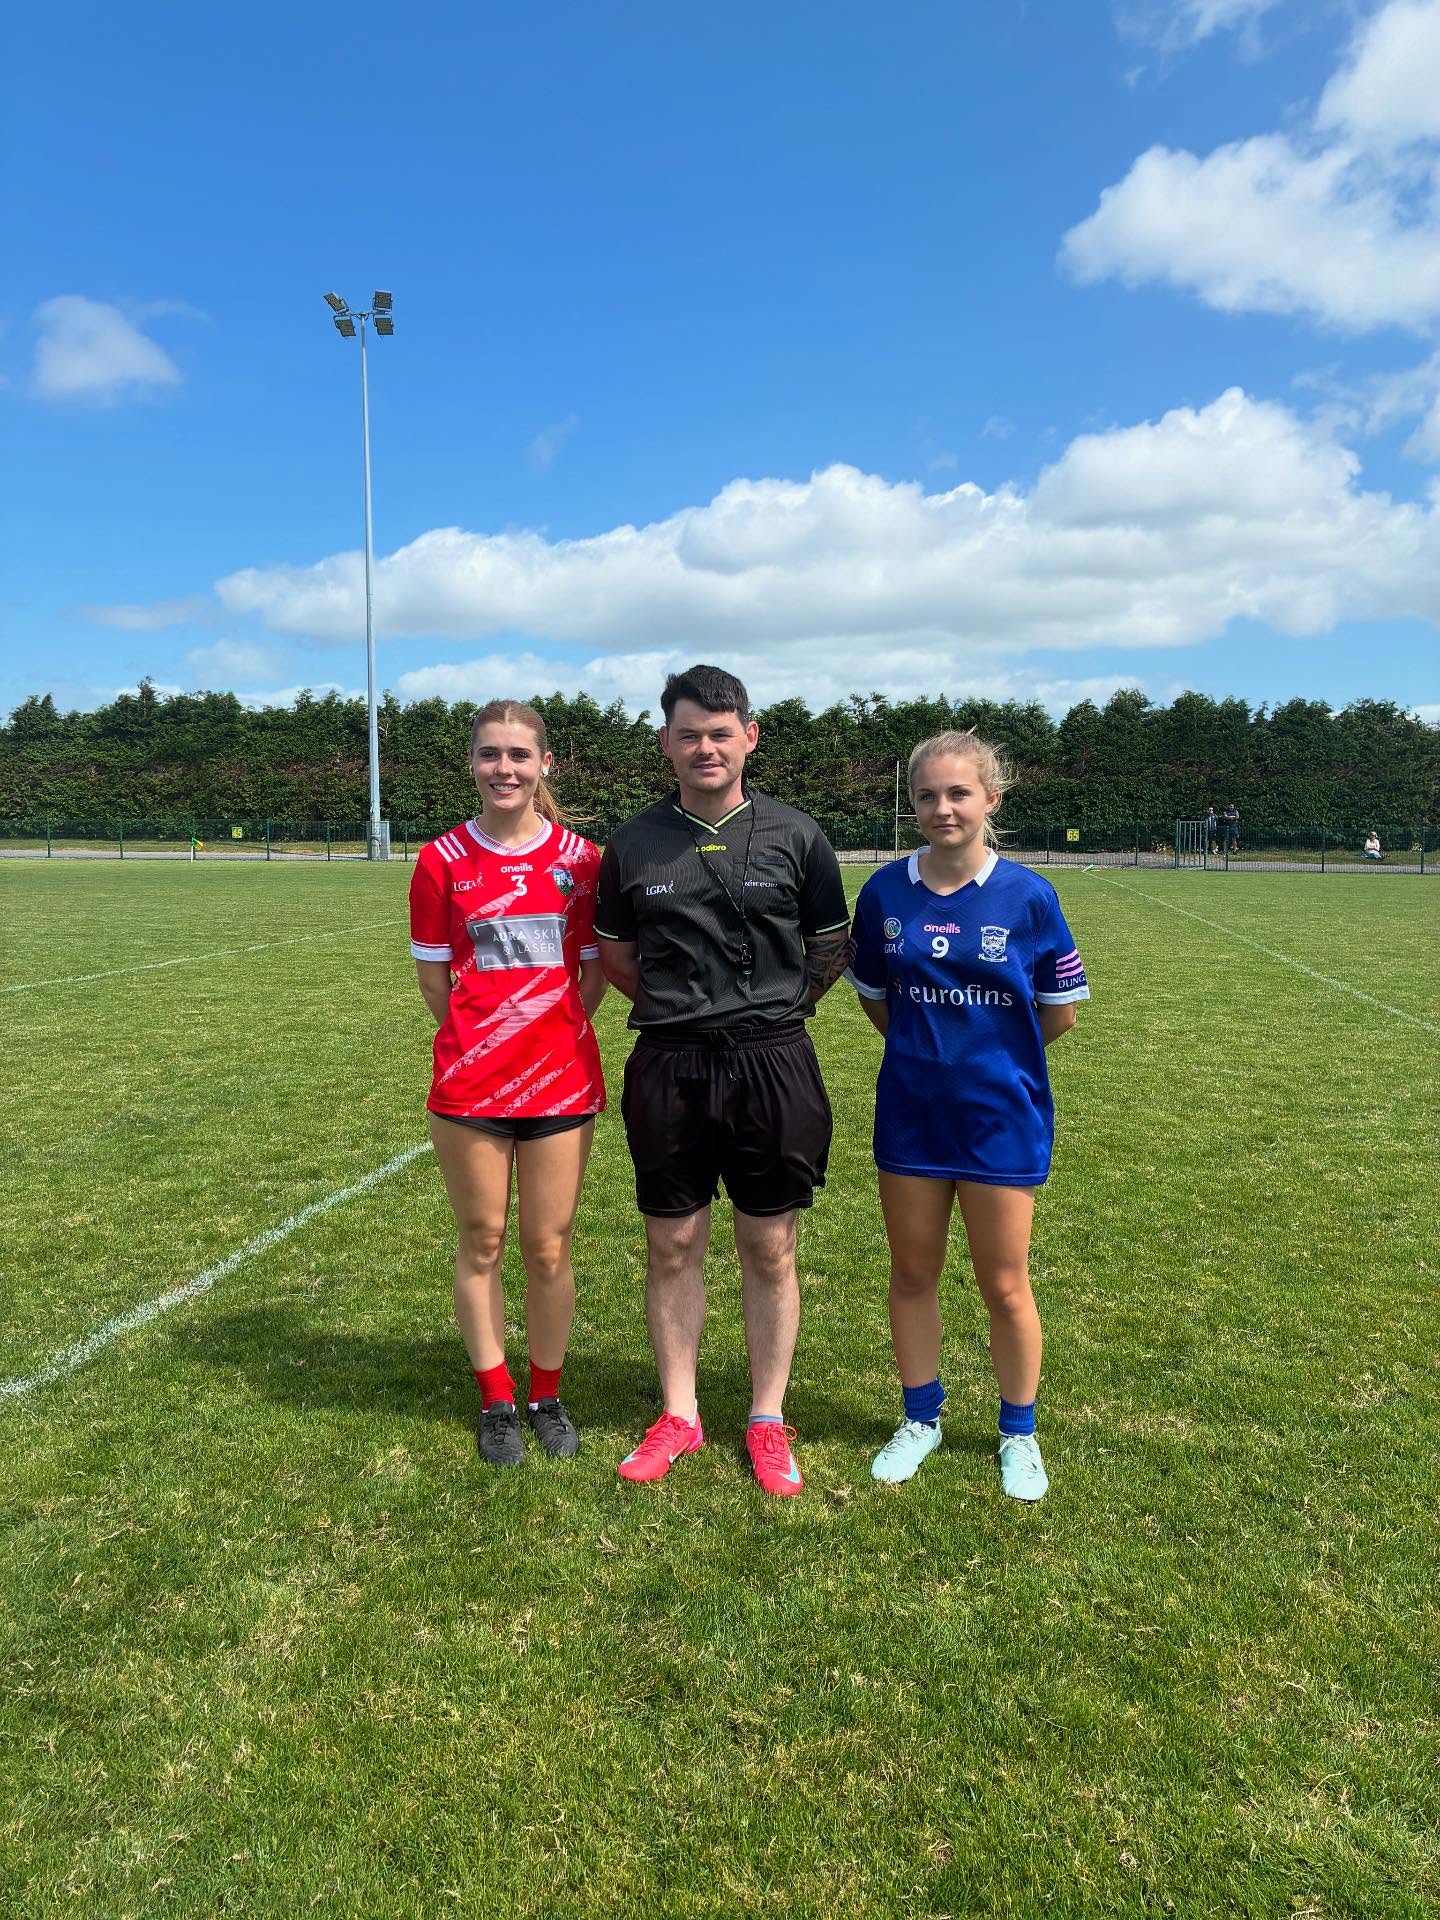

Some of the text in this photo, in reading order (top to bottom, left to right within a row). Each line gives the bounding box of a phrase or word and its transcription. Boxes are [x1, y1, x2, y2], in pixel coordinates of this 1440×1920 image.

[1067, 830, 1079, 841] 65
[511, 874, 528, 897] 3
[646, 884, 668, 896] LGFA
[493, 930, 527, 943] AURA
[504, 942, 556, 956] & LASER
[931, 935, 950, 959] 9
[909, 984, 1013, 1007] eurofins
